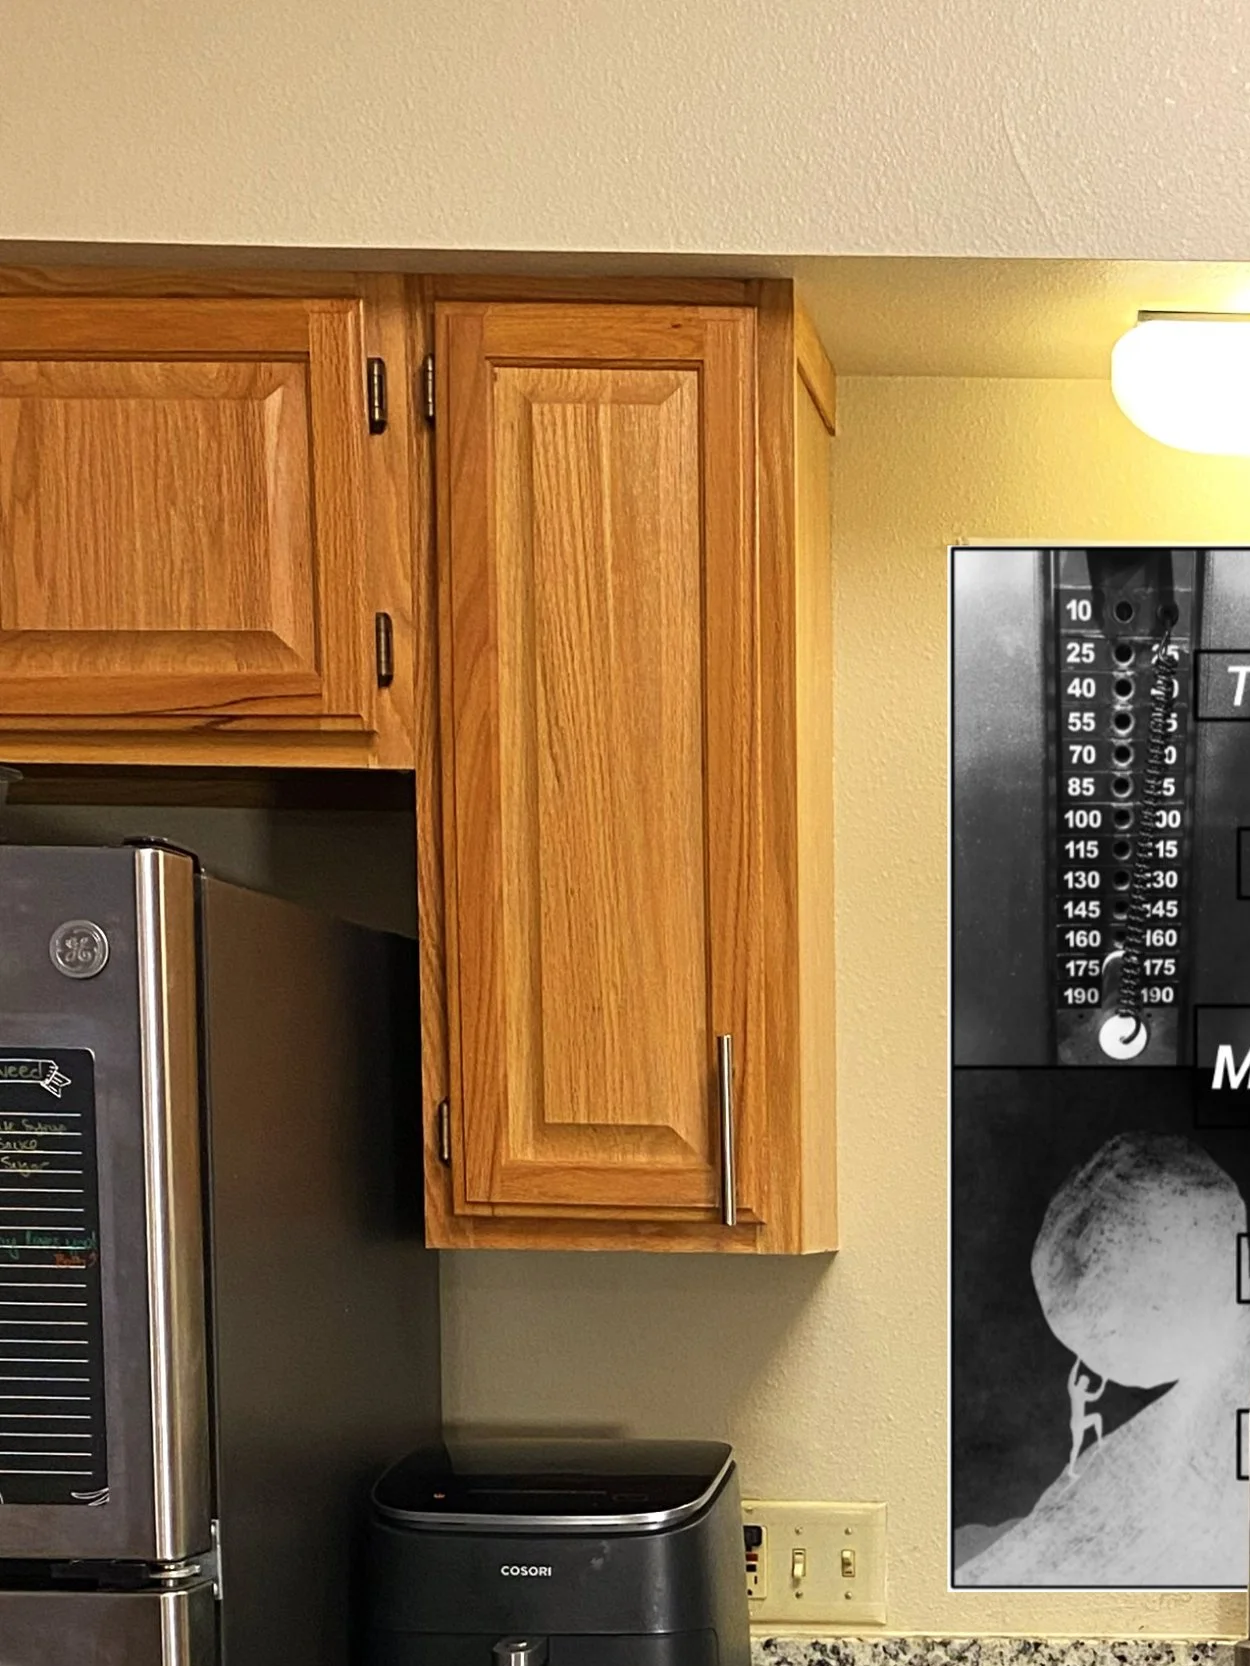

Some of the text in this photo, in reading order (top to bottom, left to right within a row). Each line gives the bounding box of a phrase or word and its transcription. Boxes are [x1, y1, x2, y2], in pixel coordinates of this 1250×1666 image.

[1067, 600, 1091, 621] 10
[1067, 643, 1094, 663] 25
[1068, 678, 1095, 697] 40
[1069, 713, 1095, 731] 55
[1070, 746, 1095, 763] 70
[1068, 778, 1094, 795] 85
[1065, 810, 1101, 828] 100
[1066, 841, 1098, 858] 115
[1064, 871, 1099, 888] 130
[1064, 901, 1100, 918] 145
[1066, 931, 1100, 947] 160
[1064, 958, 1101, 977] 175
[1143, 958, 1176, 976] 175
[1064, 989, 1098, 1003] 190
[1140, 986, 1175, 1003] 190
[501, 1566, 551, 1576] COSORI
